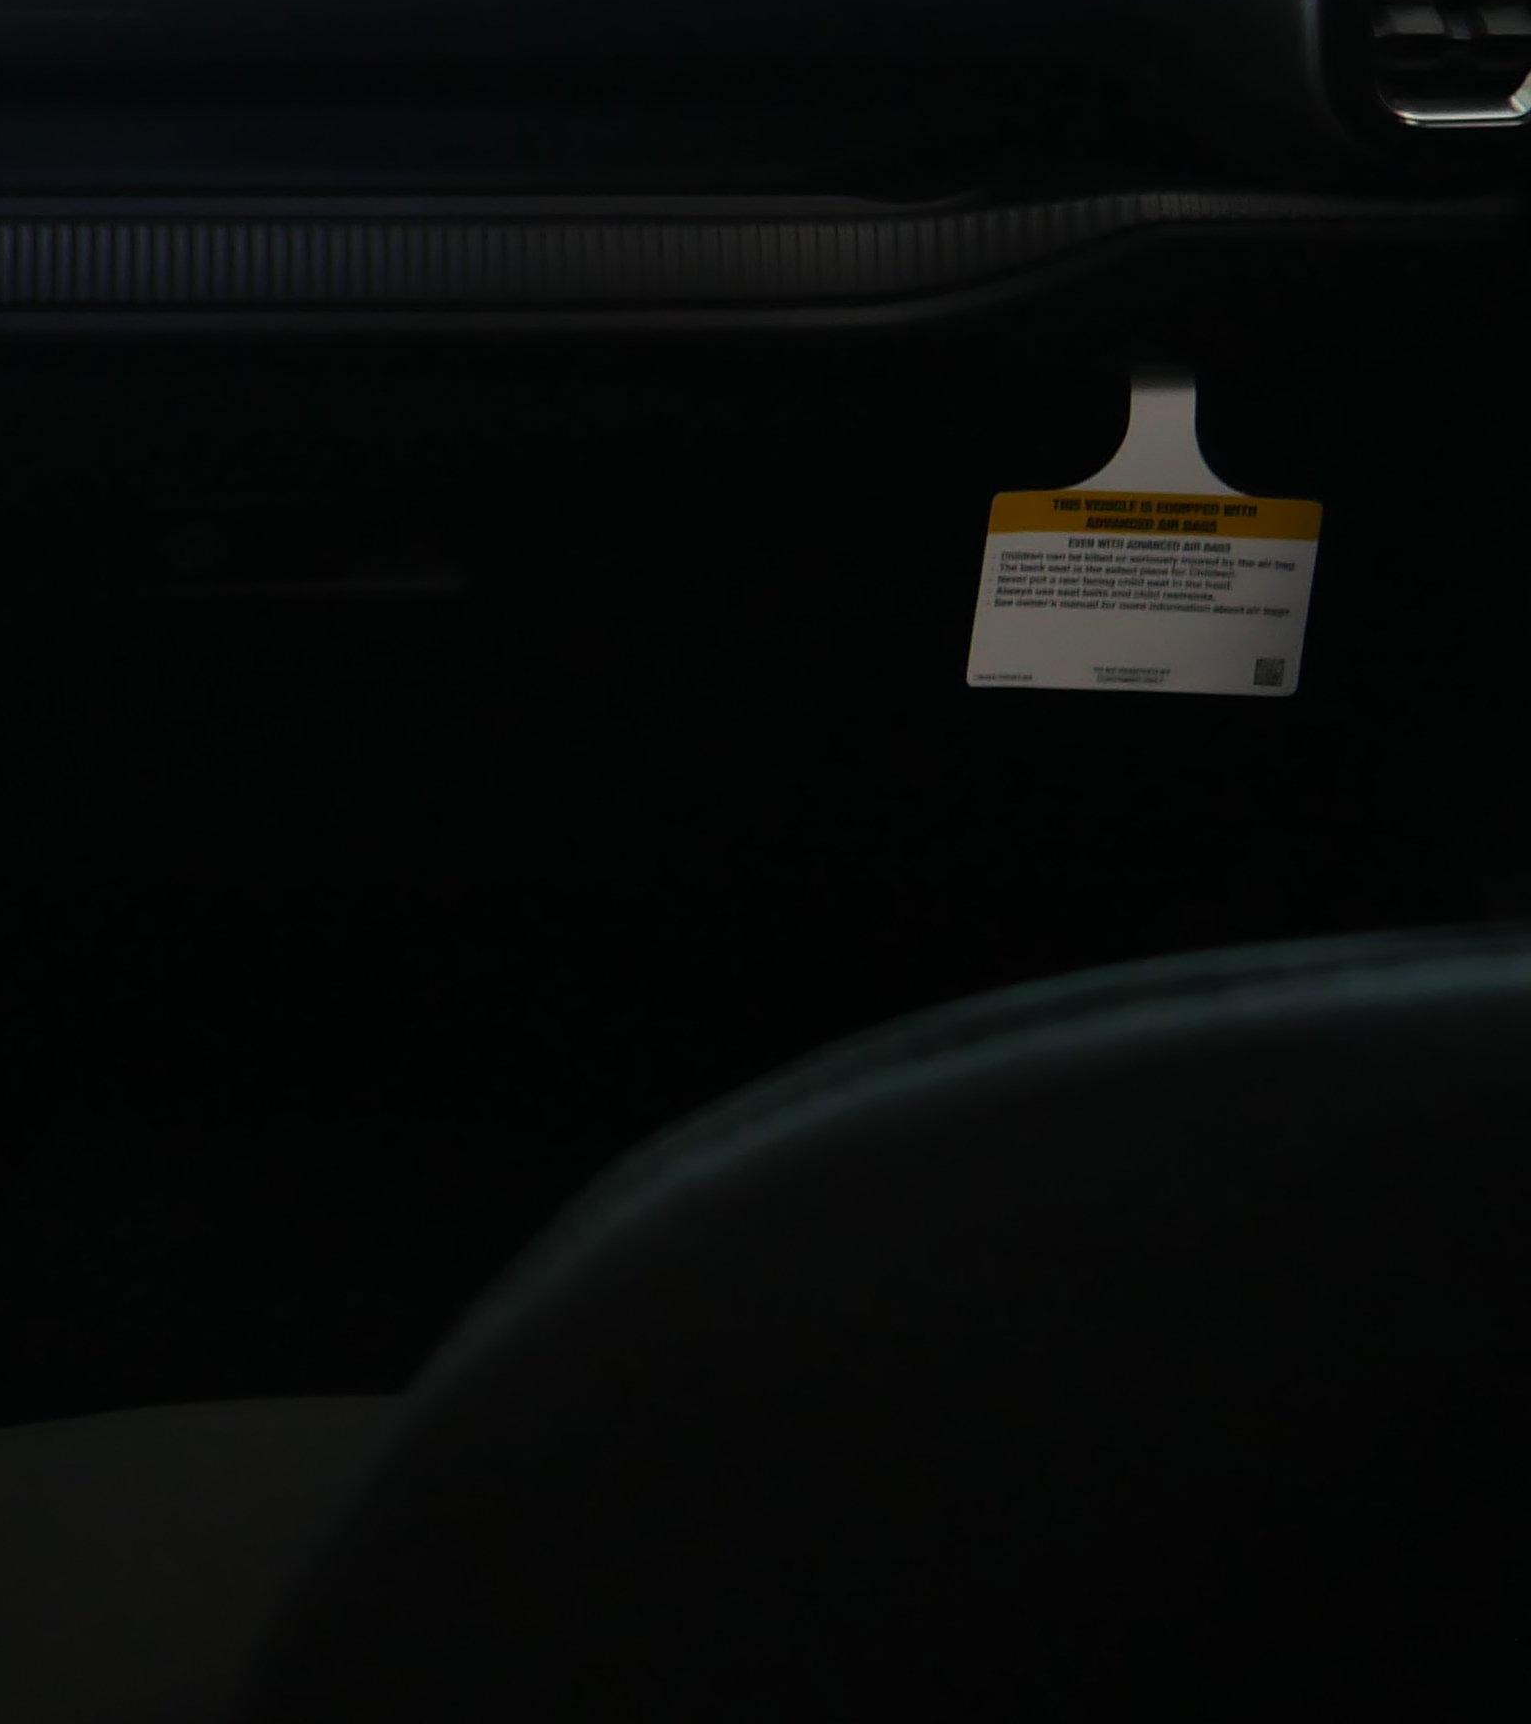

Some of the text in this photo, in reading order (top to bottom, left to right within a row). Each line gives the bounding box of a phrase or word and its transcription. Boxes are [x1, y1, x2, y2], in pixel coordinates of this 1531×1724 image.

[1054, 499, 1257, 516] THIS VEHICLE IS EQUIPPED WITH
[1086, 517, 1217, 532] ADVANCED AIR BAGS
[1068, 538, 1230, 552] EVEN WITH ADVANCED AIR BAGS
